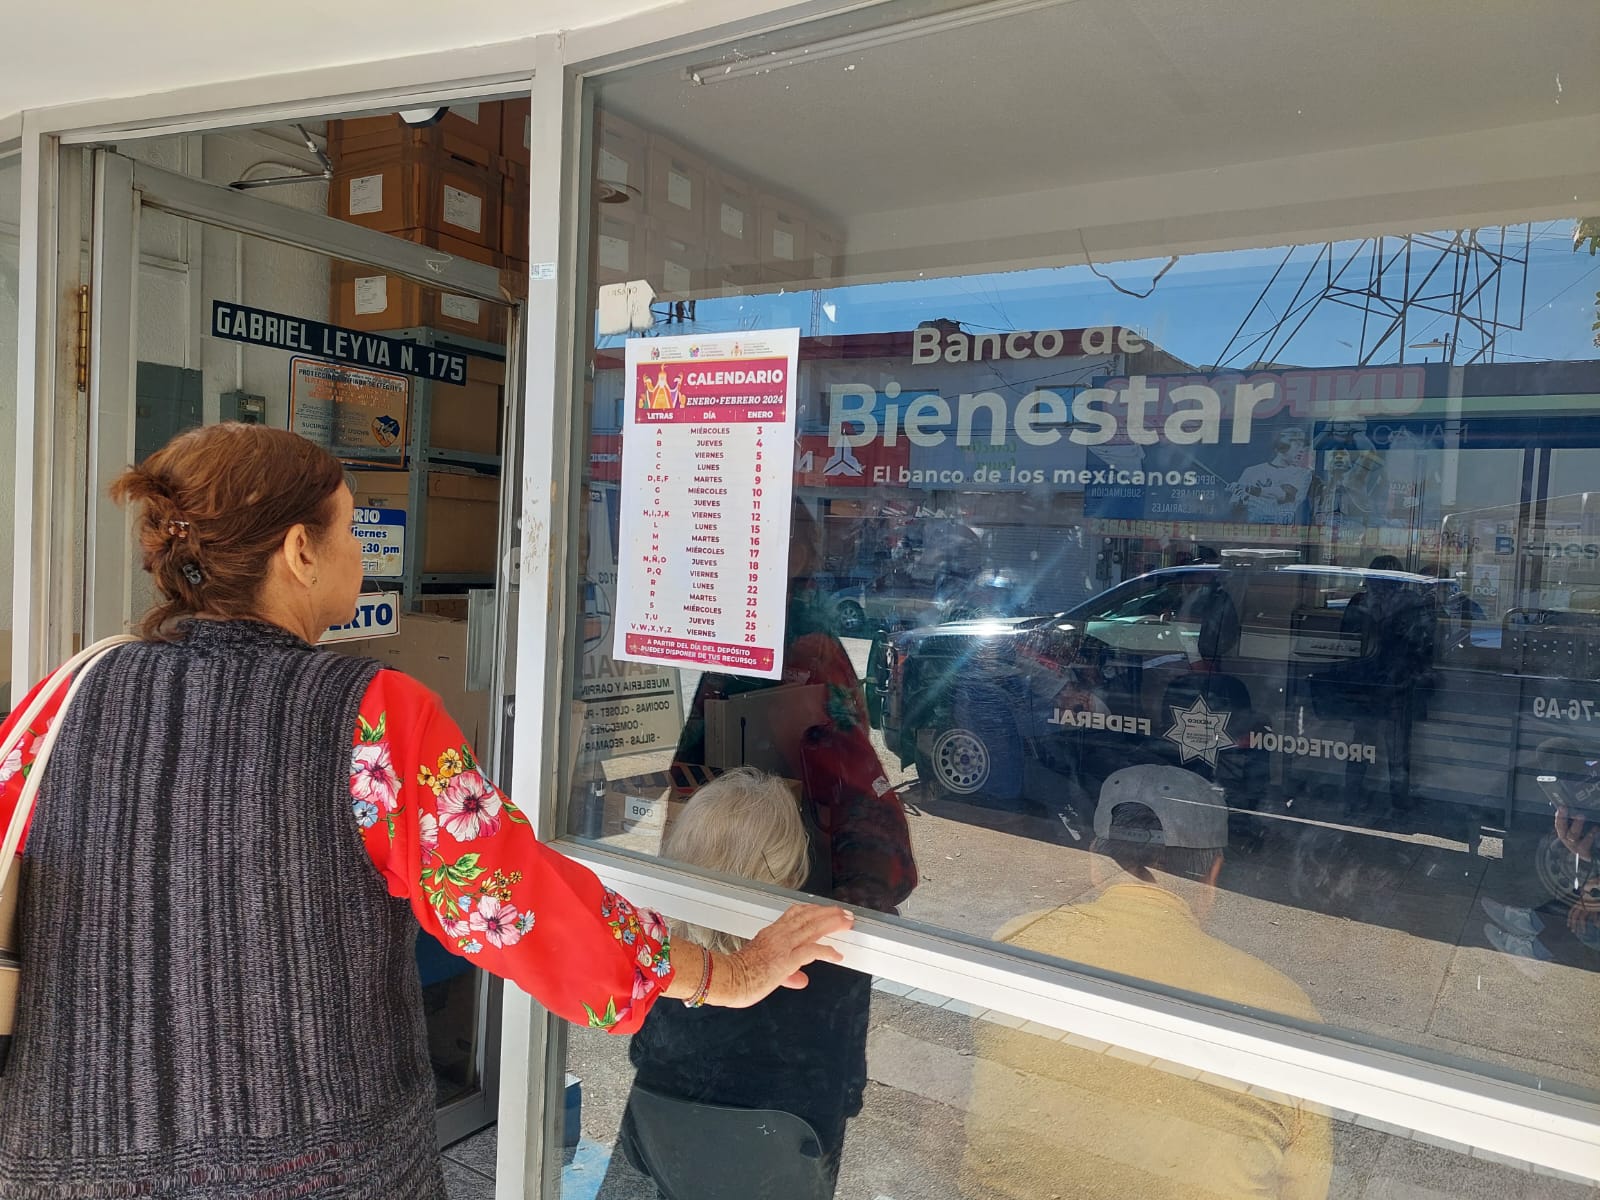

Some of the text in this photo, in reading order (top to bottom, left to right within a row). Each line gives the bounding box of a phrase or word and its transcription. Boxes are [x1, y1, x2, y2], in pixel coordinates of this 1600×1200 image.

[216, 306, 312, 350] GABRIEL
[323, 328, 391, 367] LEYVA
[400, 345, 420, 372] N.
[427, 351, 464, 381] 175
[912, 326, 1064, 365] Banco
[687, 369, 784, 387] CALENDARIO
[762, 395, 784, 405] 2024
[647, 411, 774, 420] LETRAS DÍA ENERO
[828, 374, 1275, 448] Bienestar
[690, 427, 730, 435] MIÉRCOLES
[756, 426, 763, 435] 3
[756, 439, 763, 447] 4
[756, 452, 762, 460] 5
[755, 464, 762, 472] 8
[873, 466, 891, 483] El
[899, 465, 964, 484] banco
[973, 465, 1001, 483] de
[1009, 465, 1045, 484] los
[1053, 464, 1197, 486] mexicanos
[755, 476, 761, 485] 9
[688, 487, 728, 495] MIÉRCOLES
[752, 488, 762, 497] 10
[753, 501, 761, 509] 11
[352, 508, 380, 524] RIO
[751, 513, 761, 522] 12
[751, 525, 760, 534] 15
[750, 537, 760, 546] 16
[383, 546, 400, 556] pm
[686, 546, 725, 555] MIÉRCOLES
[750, 549, 759, 558] 17
[749, 561, 759, 570] 18
[690, 571, 719, 579] VIERNES
[749, 574, 758, 582] 19
[747, 586, 758, 594] 22
[690, 594, 717, 602] MARTES
[747, 598, 757, 607] 23
[684, 605, 722, 615] MIÉRCOLES
[745, 610, 757, 618] 24
[689, 617, 715, 625] JUEVES
[745, 622, 756, 630] 25
[687, 629, 716, 638] VIERNES
[744, 634, 756, 642] 26
[641, 646, 664, 654] PUEDES
[666, 649, 696, 657] DISPONER
[722, 655, 757, 665] RECURSOS
[703, 645, 716, 653] DEL
[718, 647, 750, 656] DEPÓSITO
